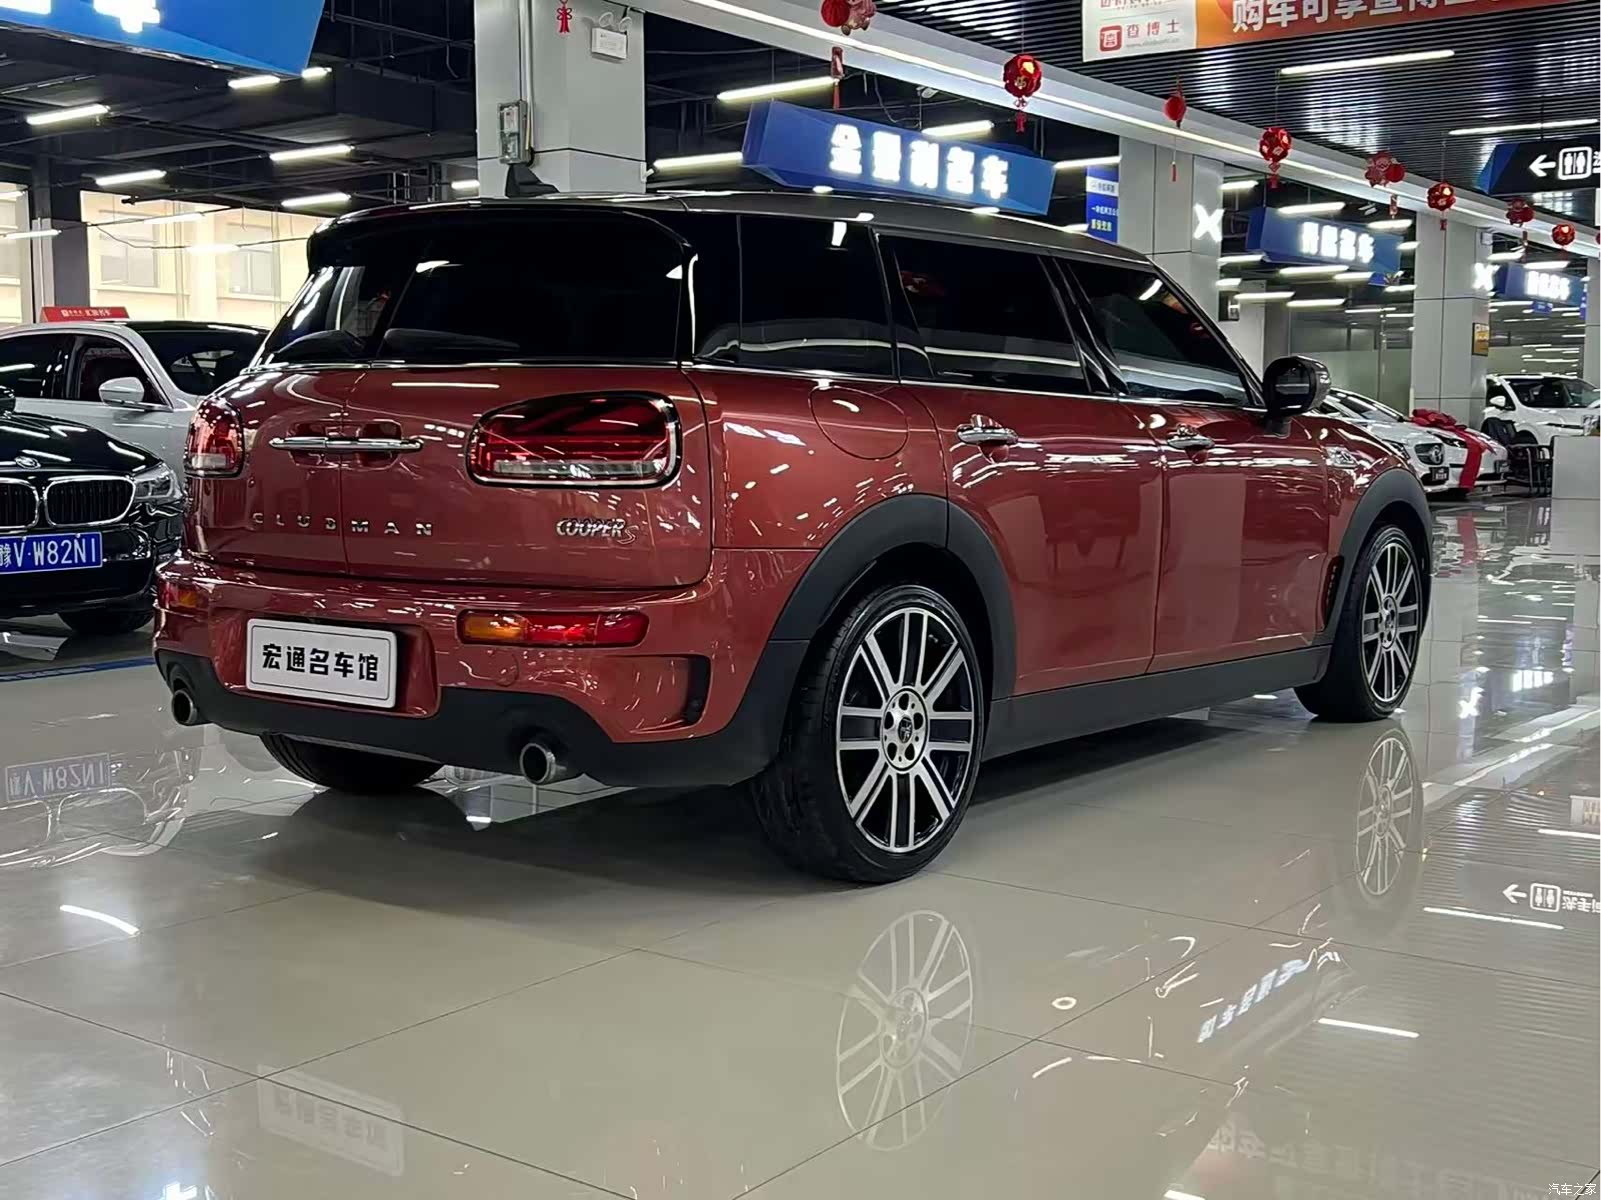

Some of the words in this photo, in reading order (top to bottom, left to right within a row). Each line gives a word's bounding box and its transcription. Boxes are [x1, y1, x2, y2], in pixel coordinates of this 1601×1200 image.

[1232, 0, 1469, 33] 购车可享
[252, 512, 432, 536] CLUBMAN
[556, 518, 626, 537] COOPER
[262, 643, 379, 682] 宏通名车馆
